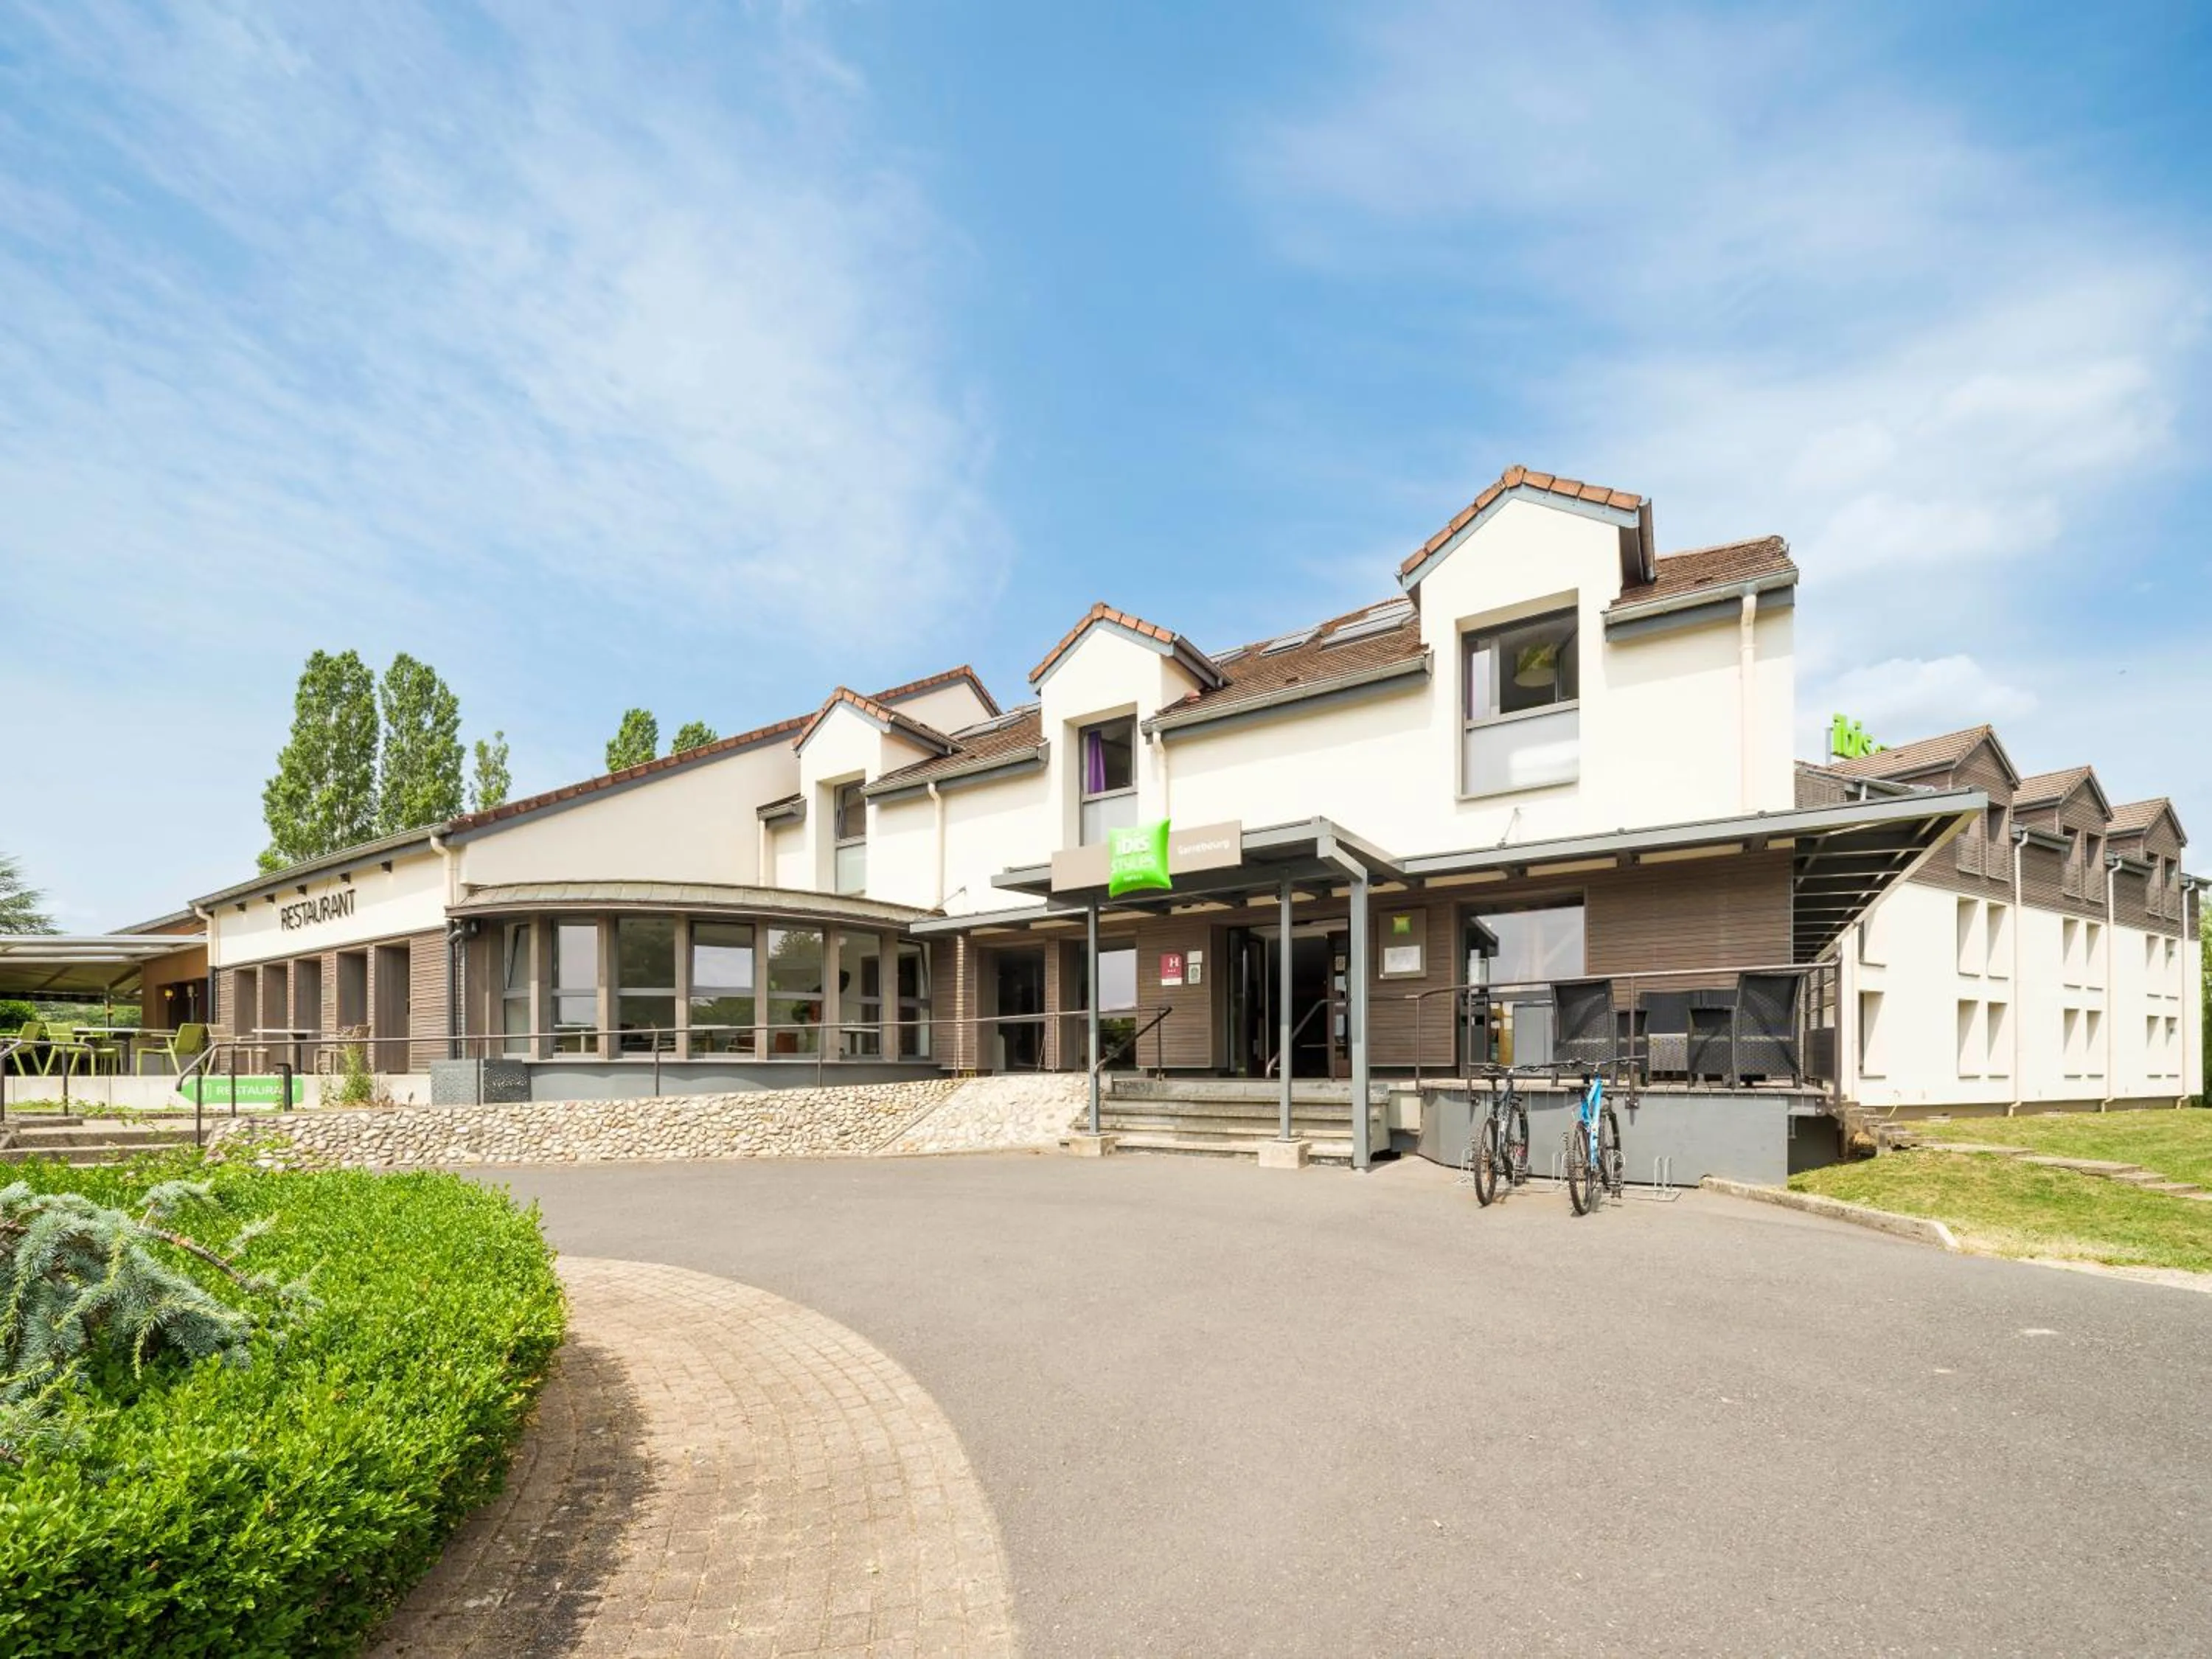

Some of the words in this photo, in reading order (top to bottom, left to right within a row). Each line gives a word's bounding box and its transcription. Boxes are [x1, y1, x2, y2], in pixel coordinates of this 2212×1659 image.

[1116, 832, 1150, 854] ibis
[281, 888, 355, 931] RESTAURANT
[216, 1085, 299, 1096] RESTAURAT
